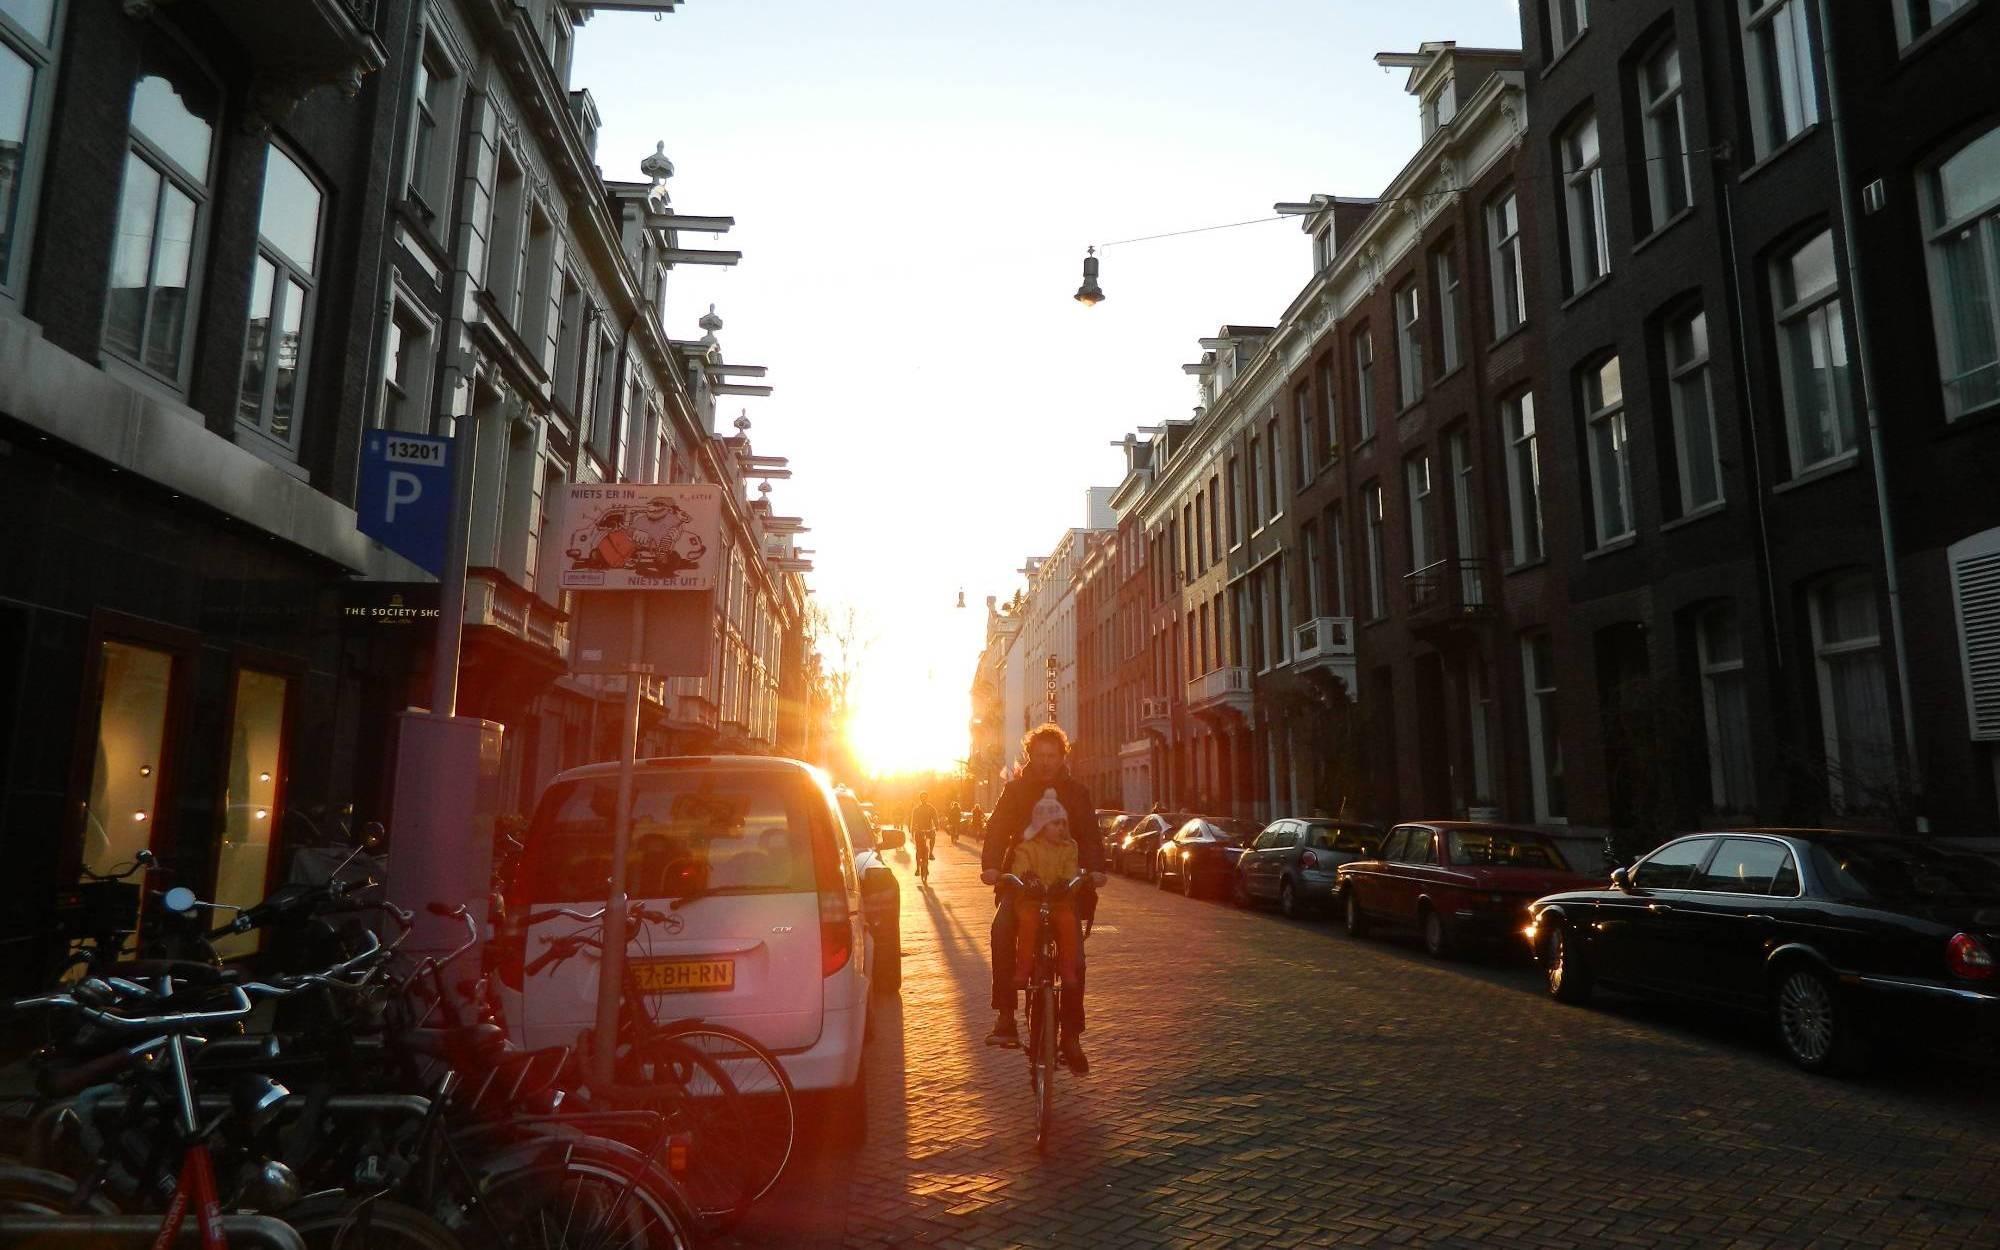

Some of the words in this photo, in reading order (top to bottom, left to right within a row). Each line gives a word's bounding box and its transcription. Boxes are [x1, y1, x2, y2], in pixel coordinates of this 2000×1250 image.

[389, 442, 440, 460] 13201
[385, 471, 422, 523] P
[571, 489, 601, 499] NIETS
[606, 489, 619, 498] ER
[623, 489, 635, 498] IN
[627, 577, 659, 586] NIETS
[663, 577, 677, 586] ER
[680, 577, 698, 586] UIT
[345, 607, 366, 616] THE
[372, 608, 418, 617] SOCIETY
[1048, 670, 1056, 723] HOTEL
